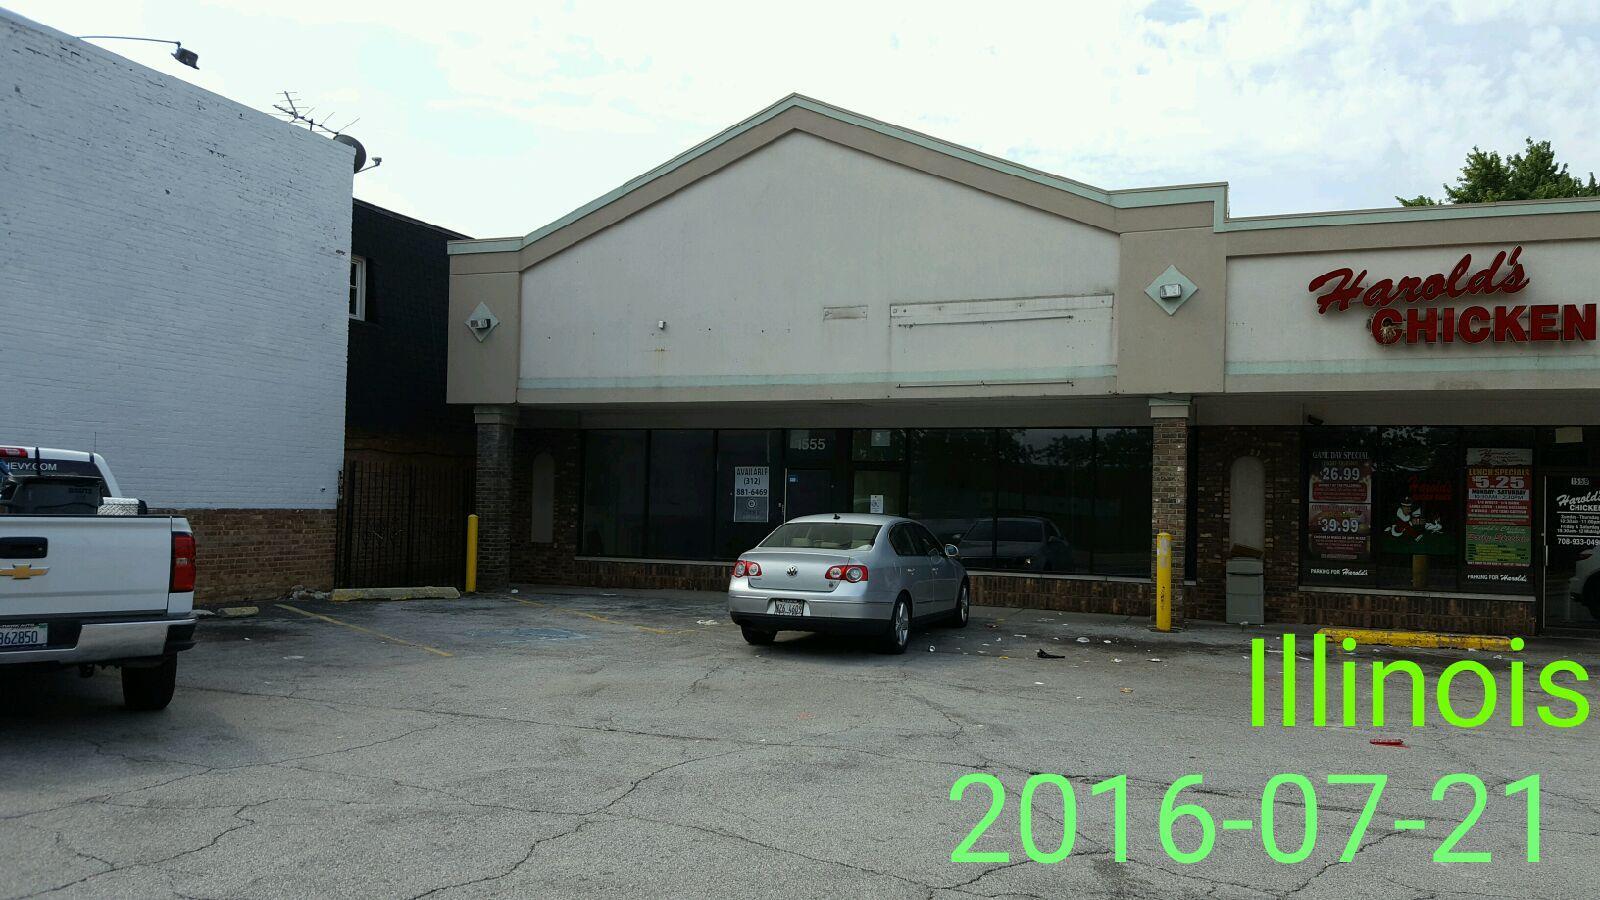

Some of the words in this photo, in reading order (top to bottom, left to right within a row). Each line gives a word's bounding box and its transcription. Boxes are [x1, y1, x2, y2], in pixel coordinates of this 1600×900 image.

[1308, 245, 1530, 314] Harold's
[1371, 303, 1598, 345] CHICKEN
[736, 468, 768, 476] AVAILABLE
[1468, 468, 1494, 476] LUNCH
[744, 477, 761, 485] (312)
[736, 488, 768, 496] 881-6469
[1569, 504, 1600, 512] CHICKE
[1557, 537, 1600, 546] 708-933-049
[1310, 568, 1330, 576] PARKING
[1331, 568, 1341, 576] FOR
